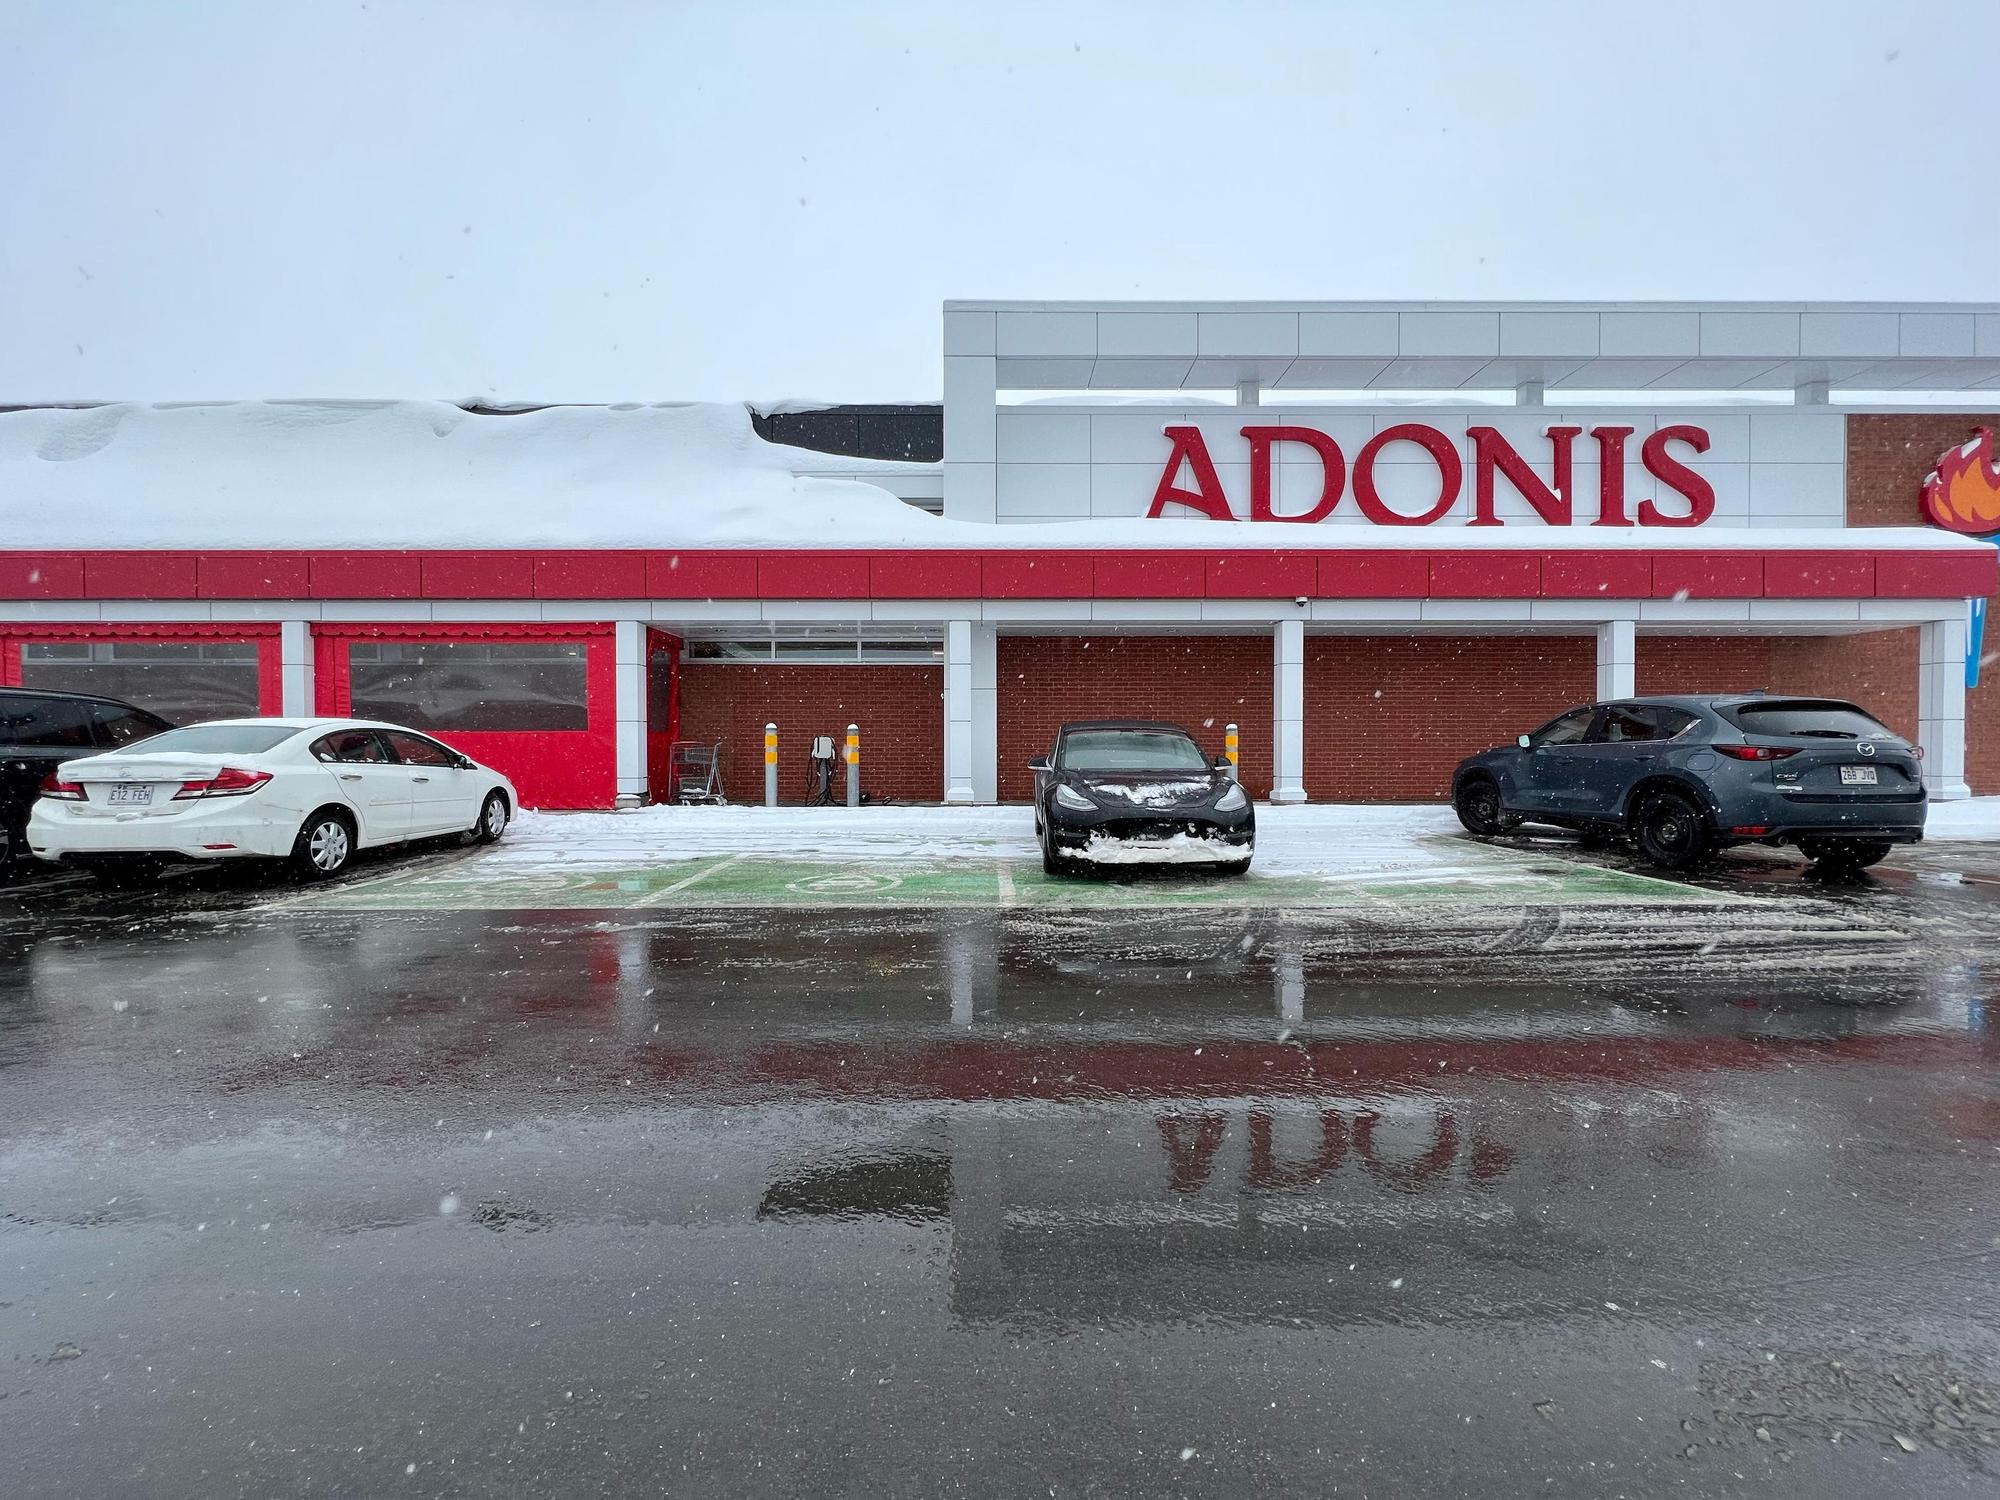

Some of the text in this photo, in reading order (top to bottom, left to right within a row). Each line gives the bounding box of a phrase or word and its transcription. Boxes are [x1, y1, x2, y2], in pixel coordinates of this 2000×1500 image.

[1146, 424, 1715, 527] ADONIS
[110, 790, 151, 800] E12 FEH
